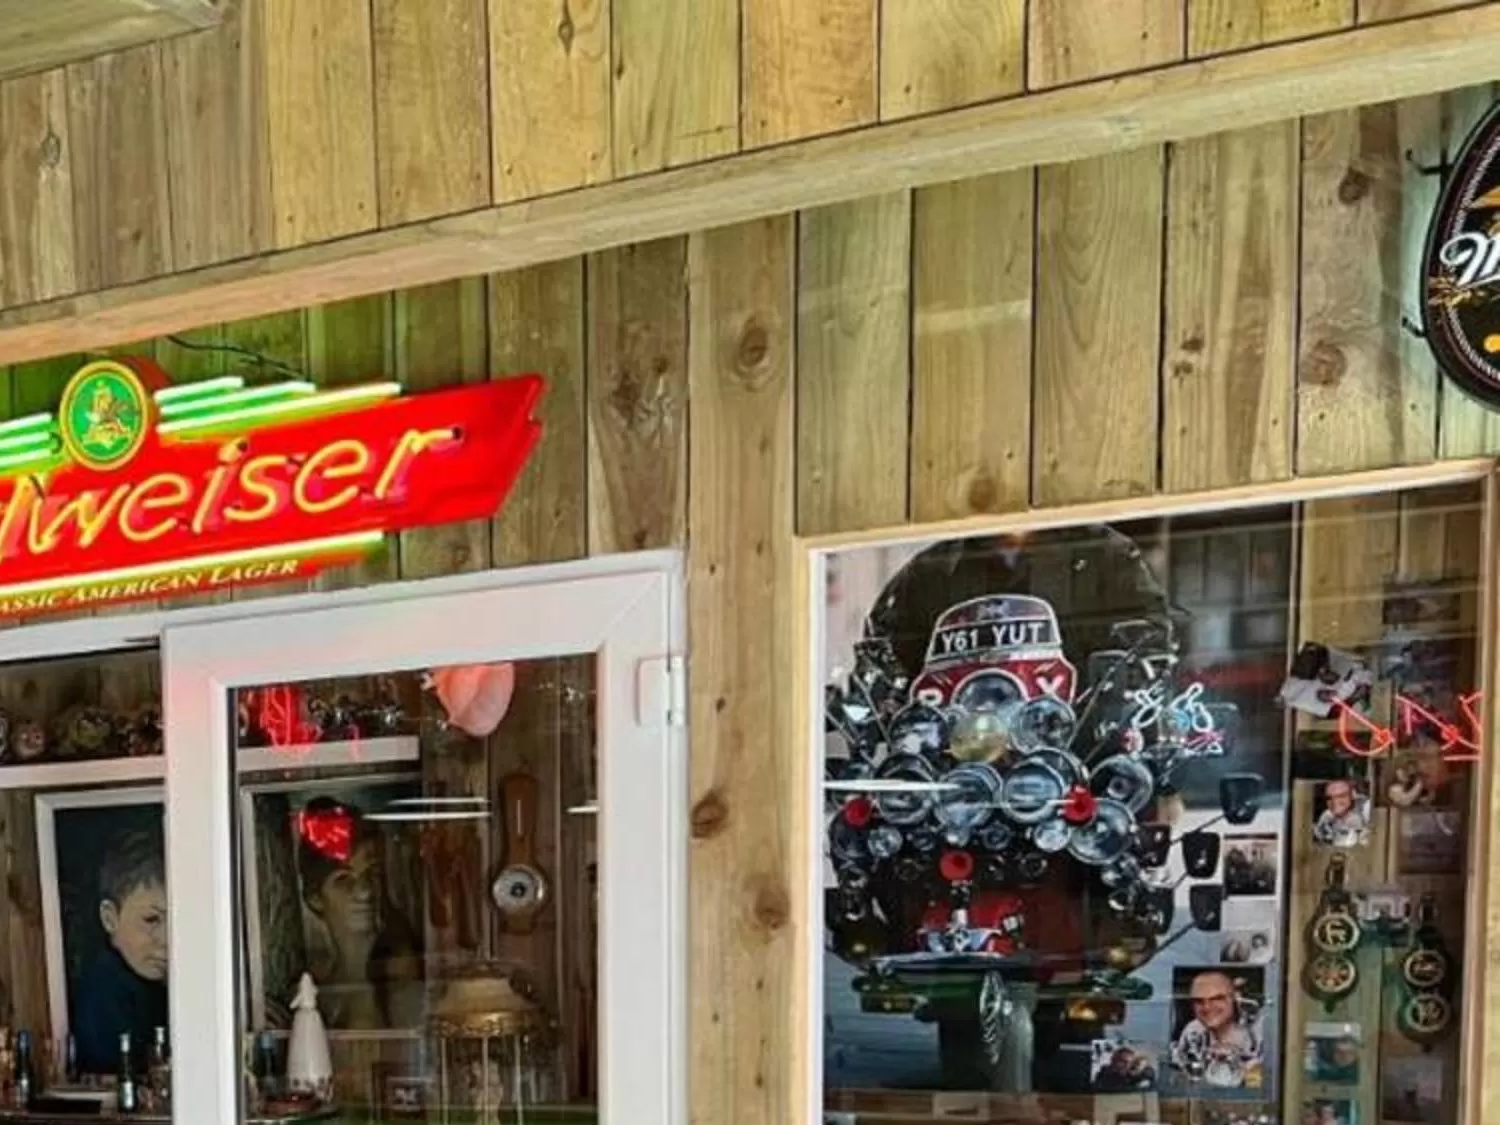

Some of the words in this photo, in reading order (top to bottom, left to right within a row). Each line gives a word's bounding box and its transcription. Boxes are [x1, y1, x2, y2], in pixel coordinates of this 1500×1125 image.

[66, 570, 202, 603] AMERICAN
[208, 559, 299, 585] LAGER
[941, 628, 979, 653] Y61
[991, 620, 1045, 646] YUT
